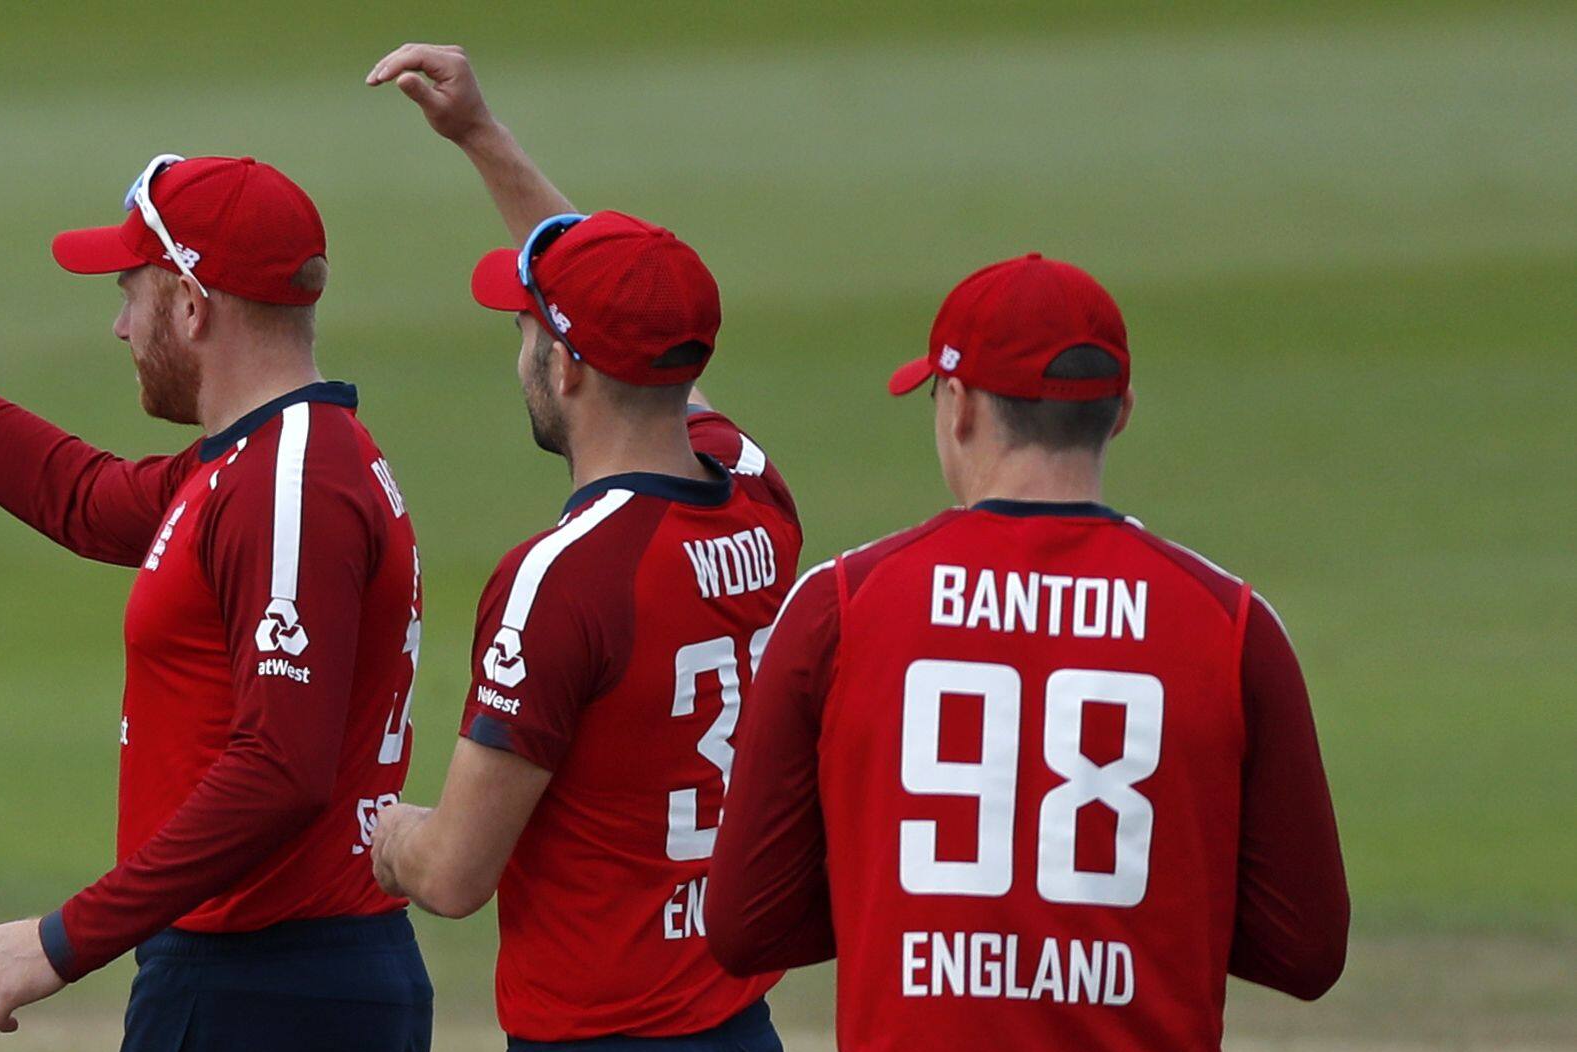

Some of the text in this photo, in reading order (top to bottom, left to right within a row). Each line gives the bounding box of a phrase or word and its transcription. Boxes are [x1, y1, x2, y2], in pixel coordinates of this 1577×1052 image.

[683, 526, 776, 598] WOOD
[930, 564, 1148, 641] BANTON
[258, 658, 310, 684] atWest
[665, 623, 774, 862] 3
[899, 658, 1165, 908] 98
[902, 931, 1135, 1006] ENGLAND
